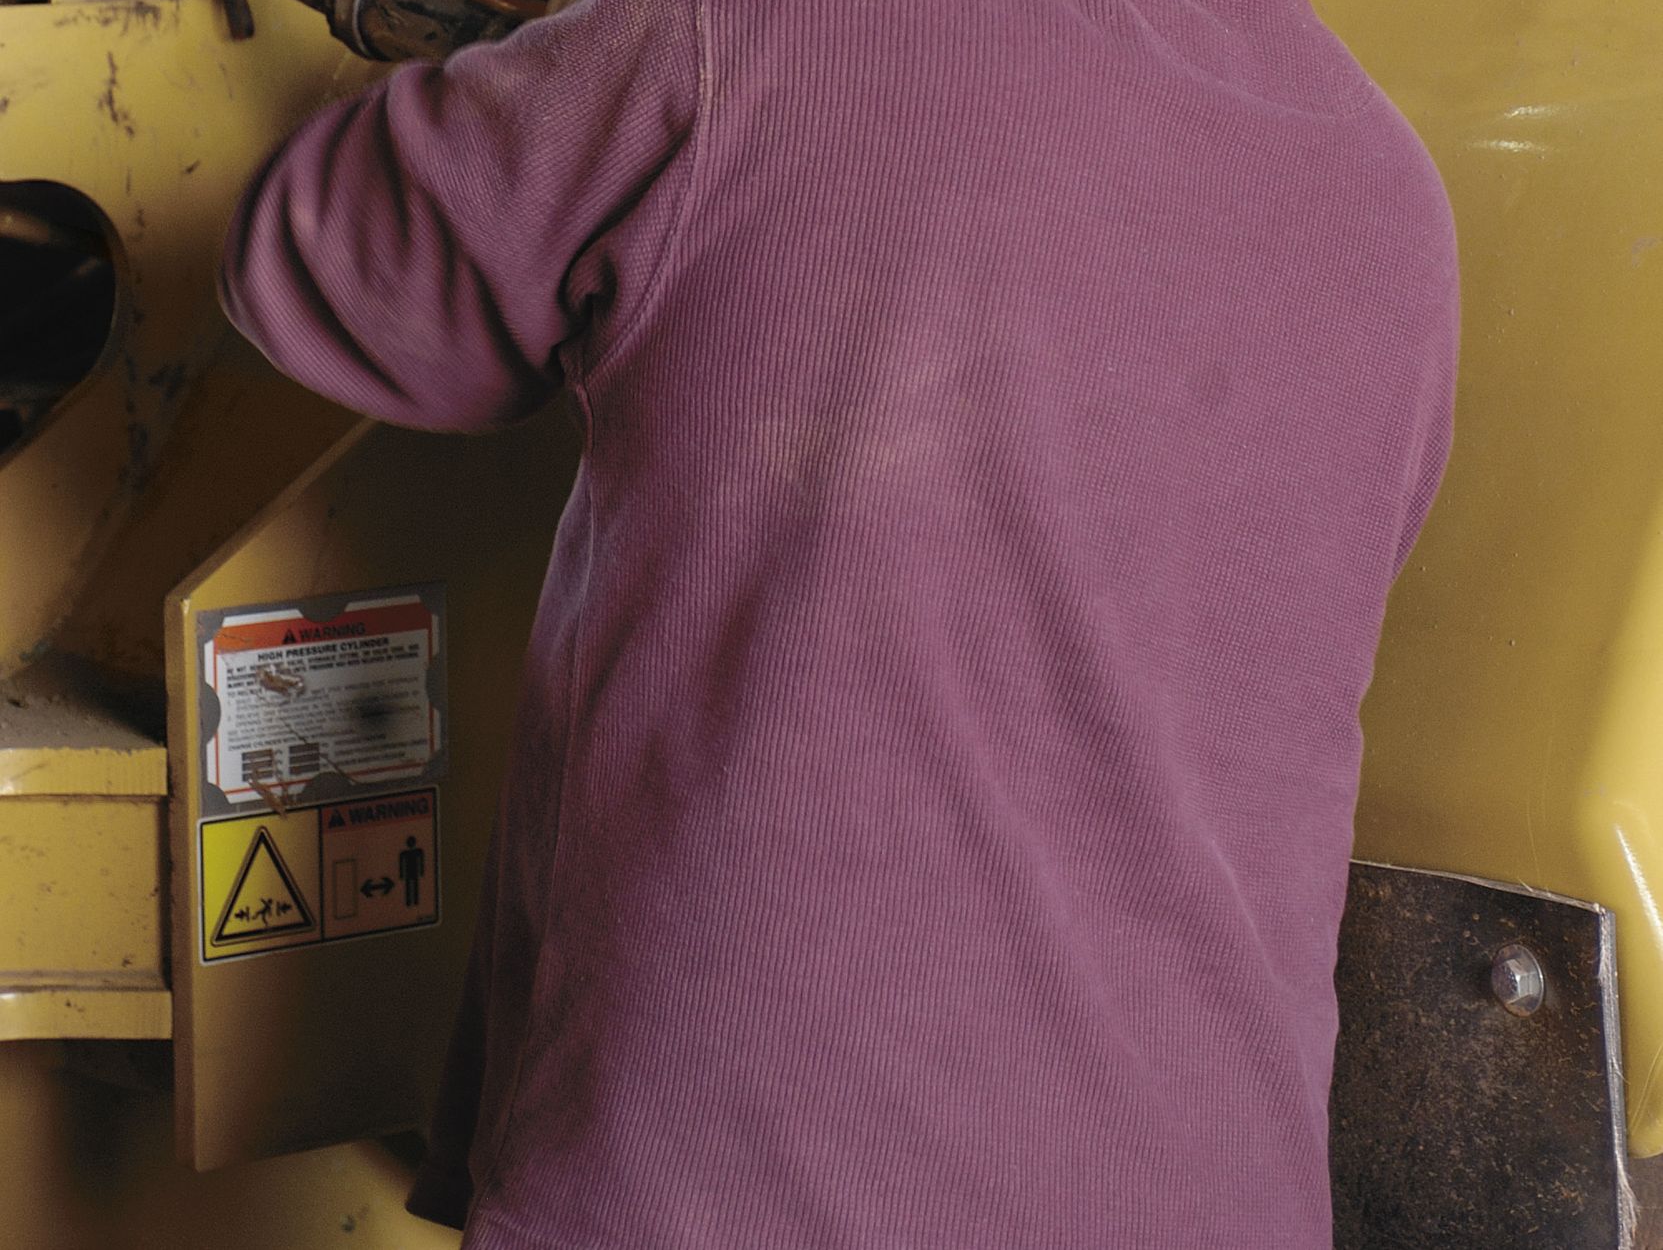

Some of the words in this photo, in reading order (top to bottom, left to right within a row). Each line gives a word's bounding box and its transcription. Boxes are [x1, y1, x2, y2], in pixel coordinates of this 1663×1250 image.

[300, 622, 366, 642] WARNING
[257, 650, 283, 662] HIGH
[286, 643, 337, 658] PRESSURE
[340, 636, 389, 652] CYLINDER
[349, 798, 429, 824] WARNING
